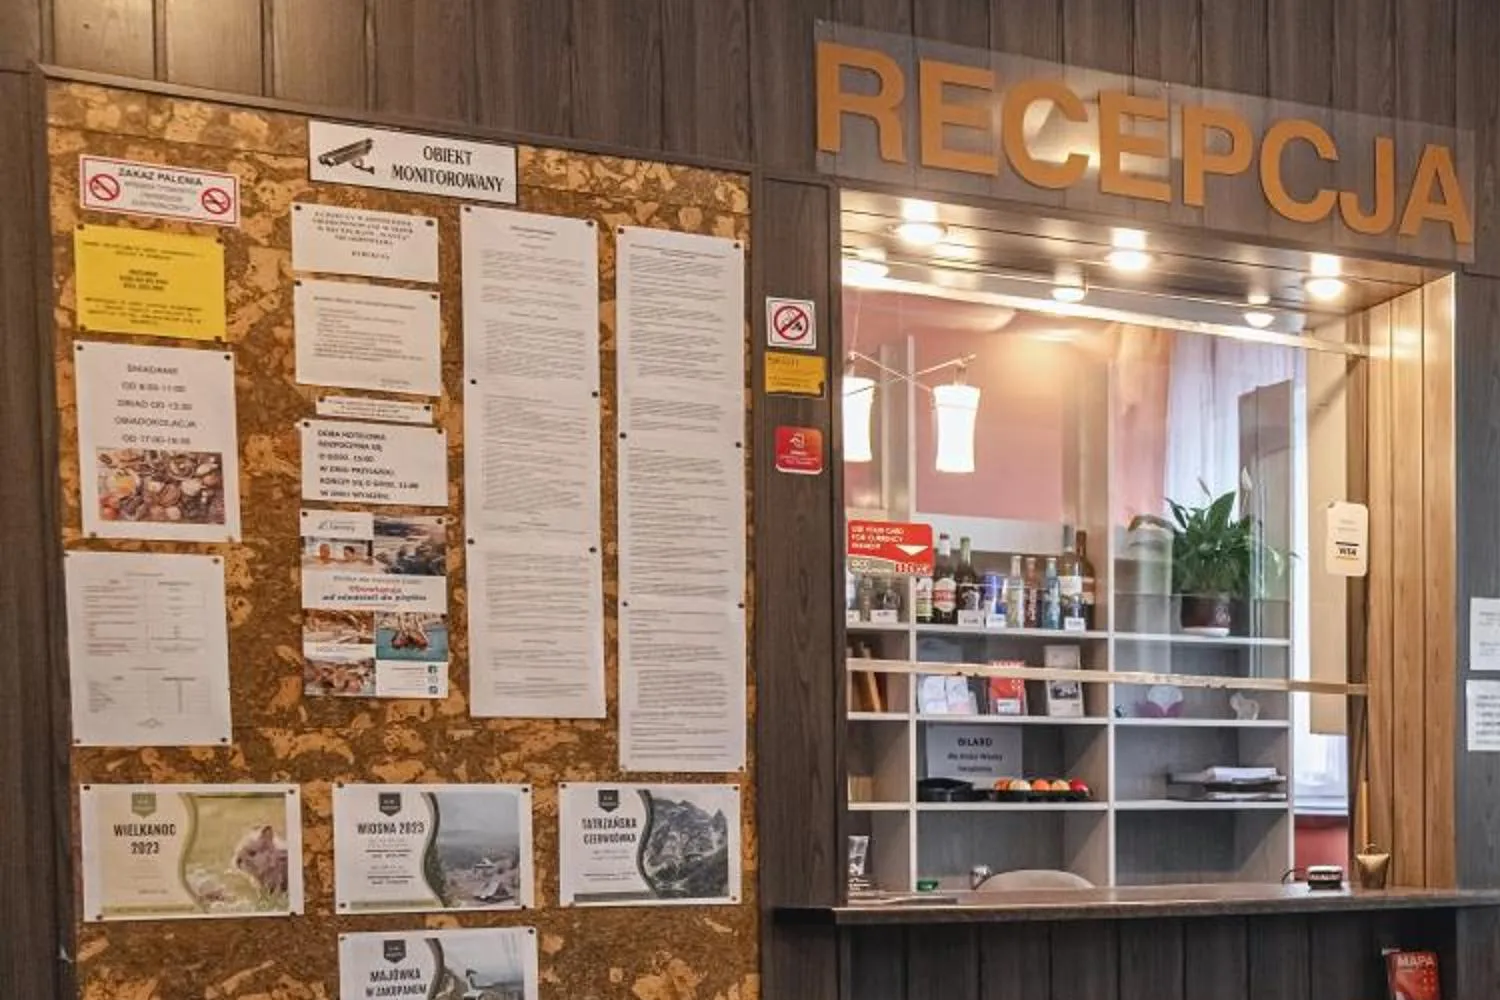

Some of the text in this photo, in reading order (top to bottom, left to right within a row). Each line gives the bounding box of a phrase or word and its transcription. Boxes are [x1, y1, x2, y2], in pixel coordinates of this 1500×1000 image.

[816, 42, 1473, 243] RECEPCJA
[423, 145, 473, 165] OBIEKT
[118, 167, 203, 185] ZAKAZ PALENIA
[391, 164, 505, 193] MONITOROWANY
[851, 533, 866, 541] FOR
[957, 736, 993, 747] BILARD
[113, 823, 177, 837] WIELKANOC
[357, 821, 425, 835] WIOSNA 2023
[130, 841, 160, 855] 2023
[369, 967, 421, 983] MAJÓWKA
[375, 983, 427, 997] ZAKOPANEM
